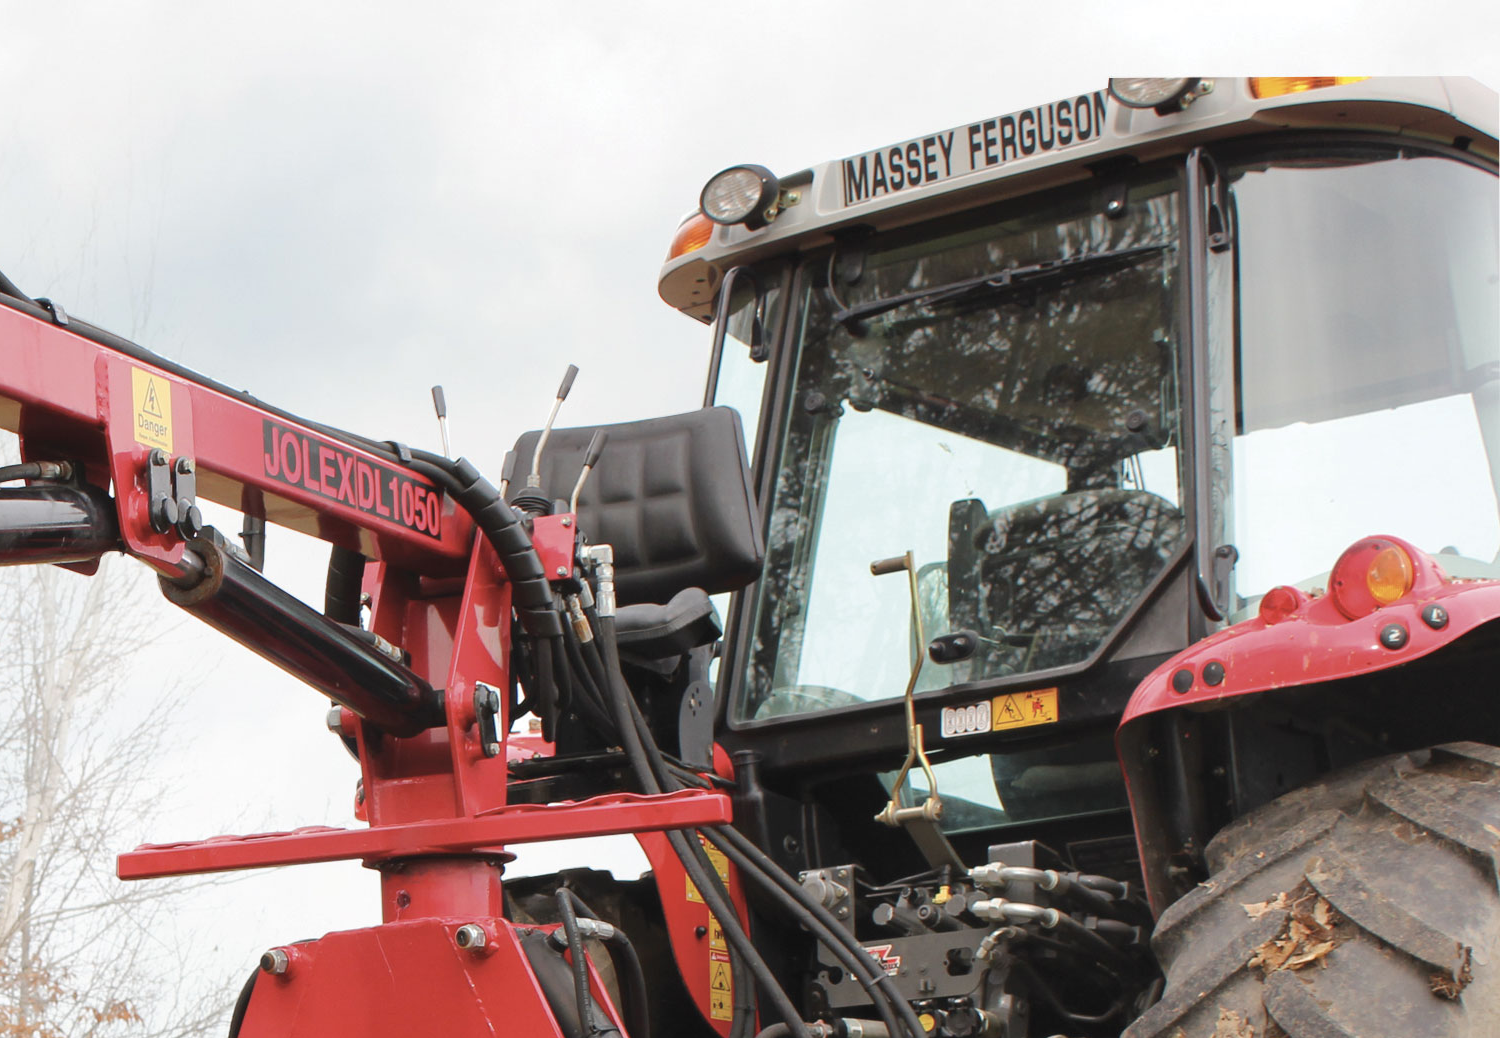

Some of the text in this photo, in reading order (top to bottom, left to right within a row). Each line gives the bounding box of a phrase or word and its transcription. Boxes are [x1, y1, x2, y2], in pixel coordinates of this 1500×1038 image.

[846, 131, 954, 203] MASSEY
[137, 413, 168, 437] Danger
[265, 427, 355, 506] JOLEX
